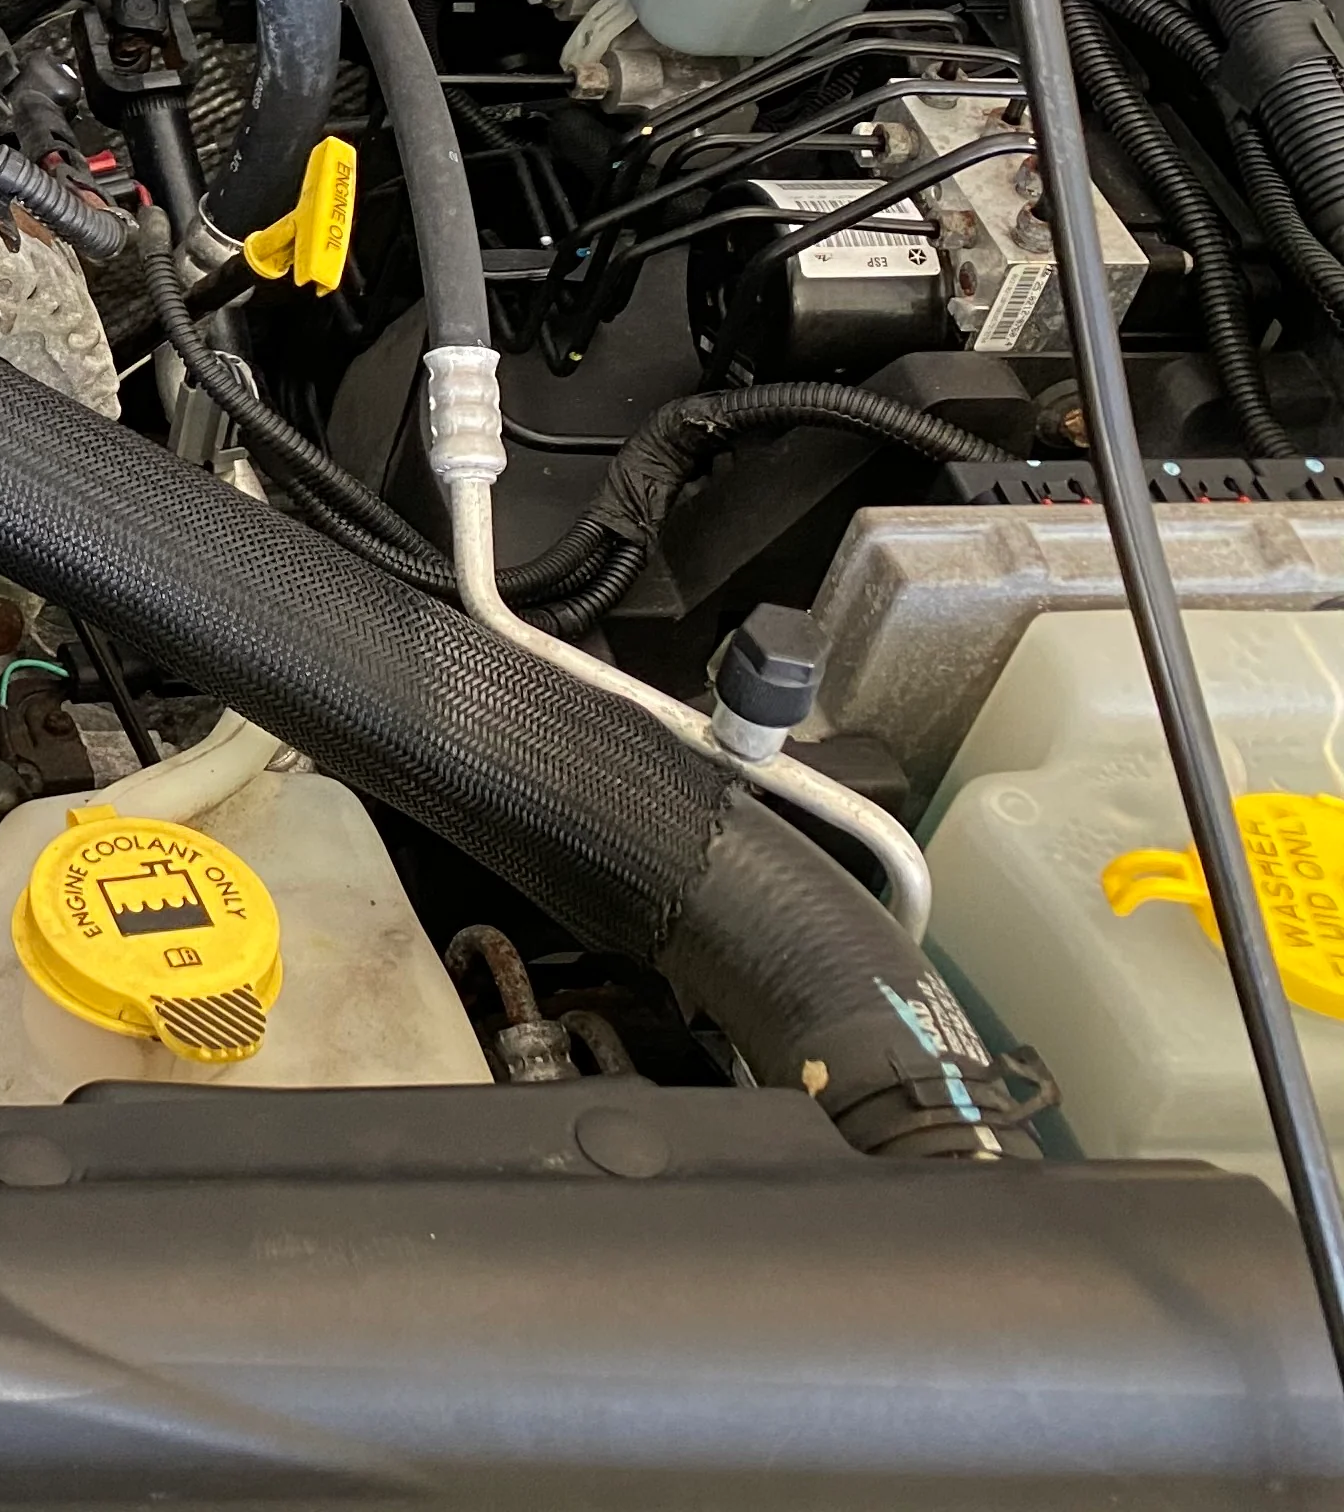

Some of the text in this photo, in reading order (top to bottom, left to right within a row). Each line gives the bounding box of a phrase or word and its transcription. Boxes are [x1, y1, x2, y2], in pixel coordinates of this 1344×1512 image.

[325, 161, 351, 252] ENGINE OIL
[867, 256, 887, 268] ESP
[64, 835, 247, 939] ENGINE COOLANT ONLY
